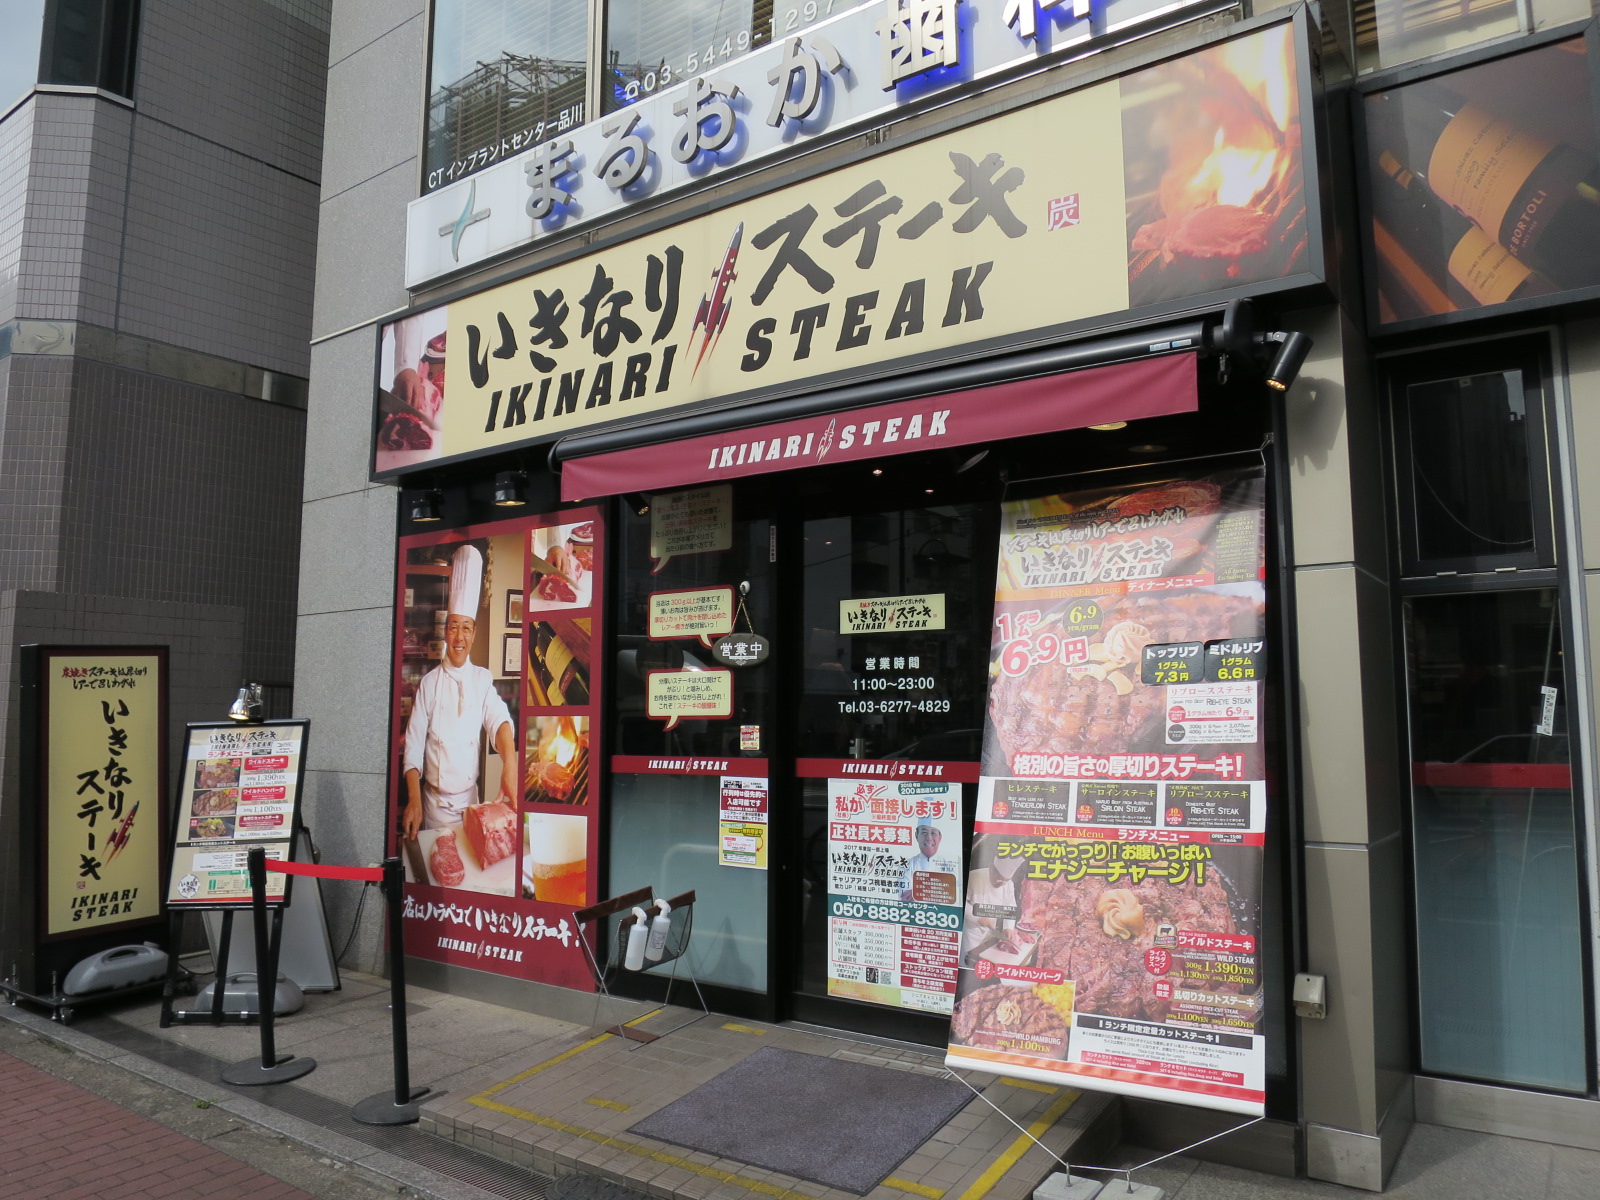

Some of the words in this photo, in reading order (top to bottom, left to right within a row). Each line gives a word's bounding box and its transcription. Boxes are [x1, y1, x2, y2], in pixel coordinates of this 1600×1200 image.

[643, 0, 834, 92] 03-5449-1297
[428, 167, 444, 189] CT
[446, 102, 583, 181] インプラントセンター品川
[1512, 189, 1548, 245] BORTOLI
[466, 244, 684, 389] いきなり
[750, 150, 1028, 306] ステーキ
[1048, 193, 1080, 231] 炭
[484, 344, 677, 433] IKINARI
[740, 260, 994, 373] STEAK
[708, 432, 813, 470] IKINARI
[838, 409, 951, 450] STEAK
[1021, 545, 1091, 574] いきなり
[1106, 538, 1173, 565] ステーキ
[1024, 570, 1086, 586] IKINARI
[1102, 562, 1161, 580] STEAK
[1050, 588, 1092, 599] DINNER
[1095, 586, 1121, 596] Menu
[1127, 575, 1204, 592] ディナーメニュー
[847, 607, 888, 624] いきなり
[896, 604, 932, 620] ステーキ
[1069, 605, 1098, 624] 6.9
[852, 622, 887, 631] IKINARI
[895, 619, 928, 629] STEAK
[720, 641, 763, 657] 営業中
[1209, 641, 1264, 656] ミドルリブ
[865, 656, 920, 671] 営業時間
[1157, 661, 1187, 670] 1グラム
[1221, 657, 1252, 666] 1グラム
[1154, 671, 1190, 683] 7.3円
[1217, 667, 1255, 680] 6.6円
[1171, 685, 1253, 696] リブロースステーキ
[838, 699, 951, 714] Tel.03-6277-4829
[1232, 697, 1253, 705] STEAK
[101, 699, 132, 820] いきなり
[208, 750, 250, 758] ランチメニュー
[648, 760, 685, 770] IKINARI
[693, 761, 729, 771] STEAK
[842, 763, 889, 774] IKINARI
[899, 764, 944, 776] STEAK
[1014, 754, 1242, 777] 格別の旨さの厚切りステーキ！
[1008, 784, 1058, 794] ヒレステーキ
[1082, 788, 1156, 798] サーロインステーキ
[1170, 790, 1249, 799] リブロースステーキ
[870, 798, 956, 818] 面接します！
[1047, 802, 1067, 810] STEAK
[1126, 805, 1147, 813] STEAK
[1218, 807, 1240, 815] STEAK
[76, 769, 105, 880] ステーキ
[832, 824, 911, 844] 正社員大募集
[1033, 826, 1073, 838] LUNCH
[1077, 828, 1104, 839] Menu
[1118, 829, 1190, 841] ランチメニュー
[831, 851, 868, 866] いきなり
[875, 854, 910, 869] ステーキ
[997, 842, 1212, 861] ランチでがっつり！お腹いっぱい
[834, 865, 866, 874] IKINARI
[874, 868, 905, 877] STEAK
[1027, 860, 1205, 885] エナジーチャージ！
[70, 887, 139, 910] IKINARI
[72, 900, 133, 922] STEAK
[437, 937, 476, 954] IKINARI
[485, 946, 524, 963] STEAK
[1178, 936, 1252, 951] ワイルドステーキ
[1216, 954, 1234, 963] WILD
[1234, 956, 1255, 964] STEAK
[997, 966, 1062, 982] ワイルドハンバーグ
[1173, 990, 1255, 1007] 乱切りカットステーキ
[1015, 1032, 1030, 1040] WILD
[1031, 1034, 1061, 1046] HAMBURG
[1104, 1022, 1214, 1043] ランチ限定定量カットステーキ
